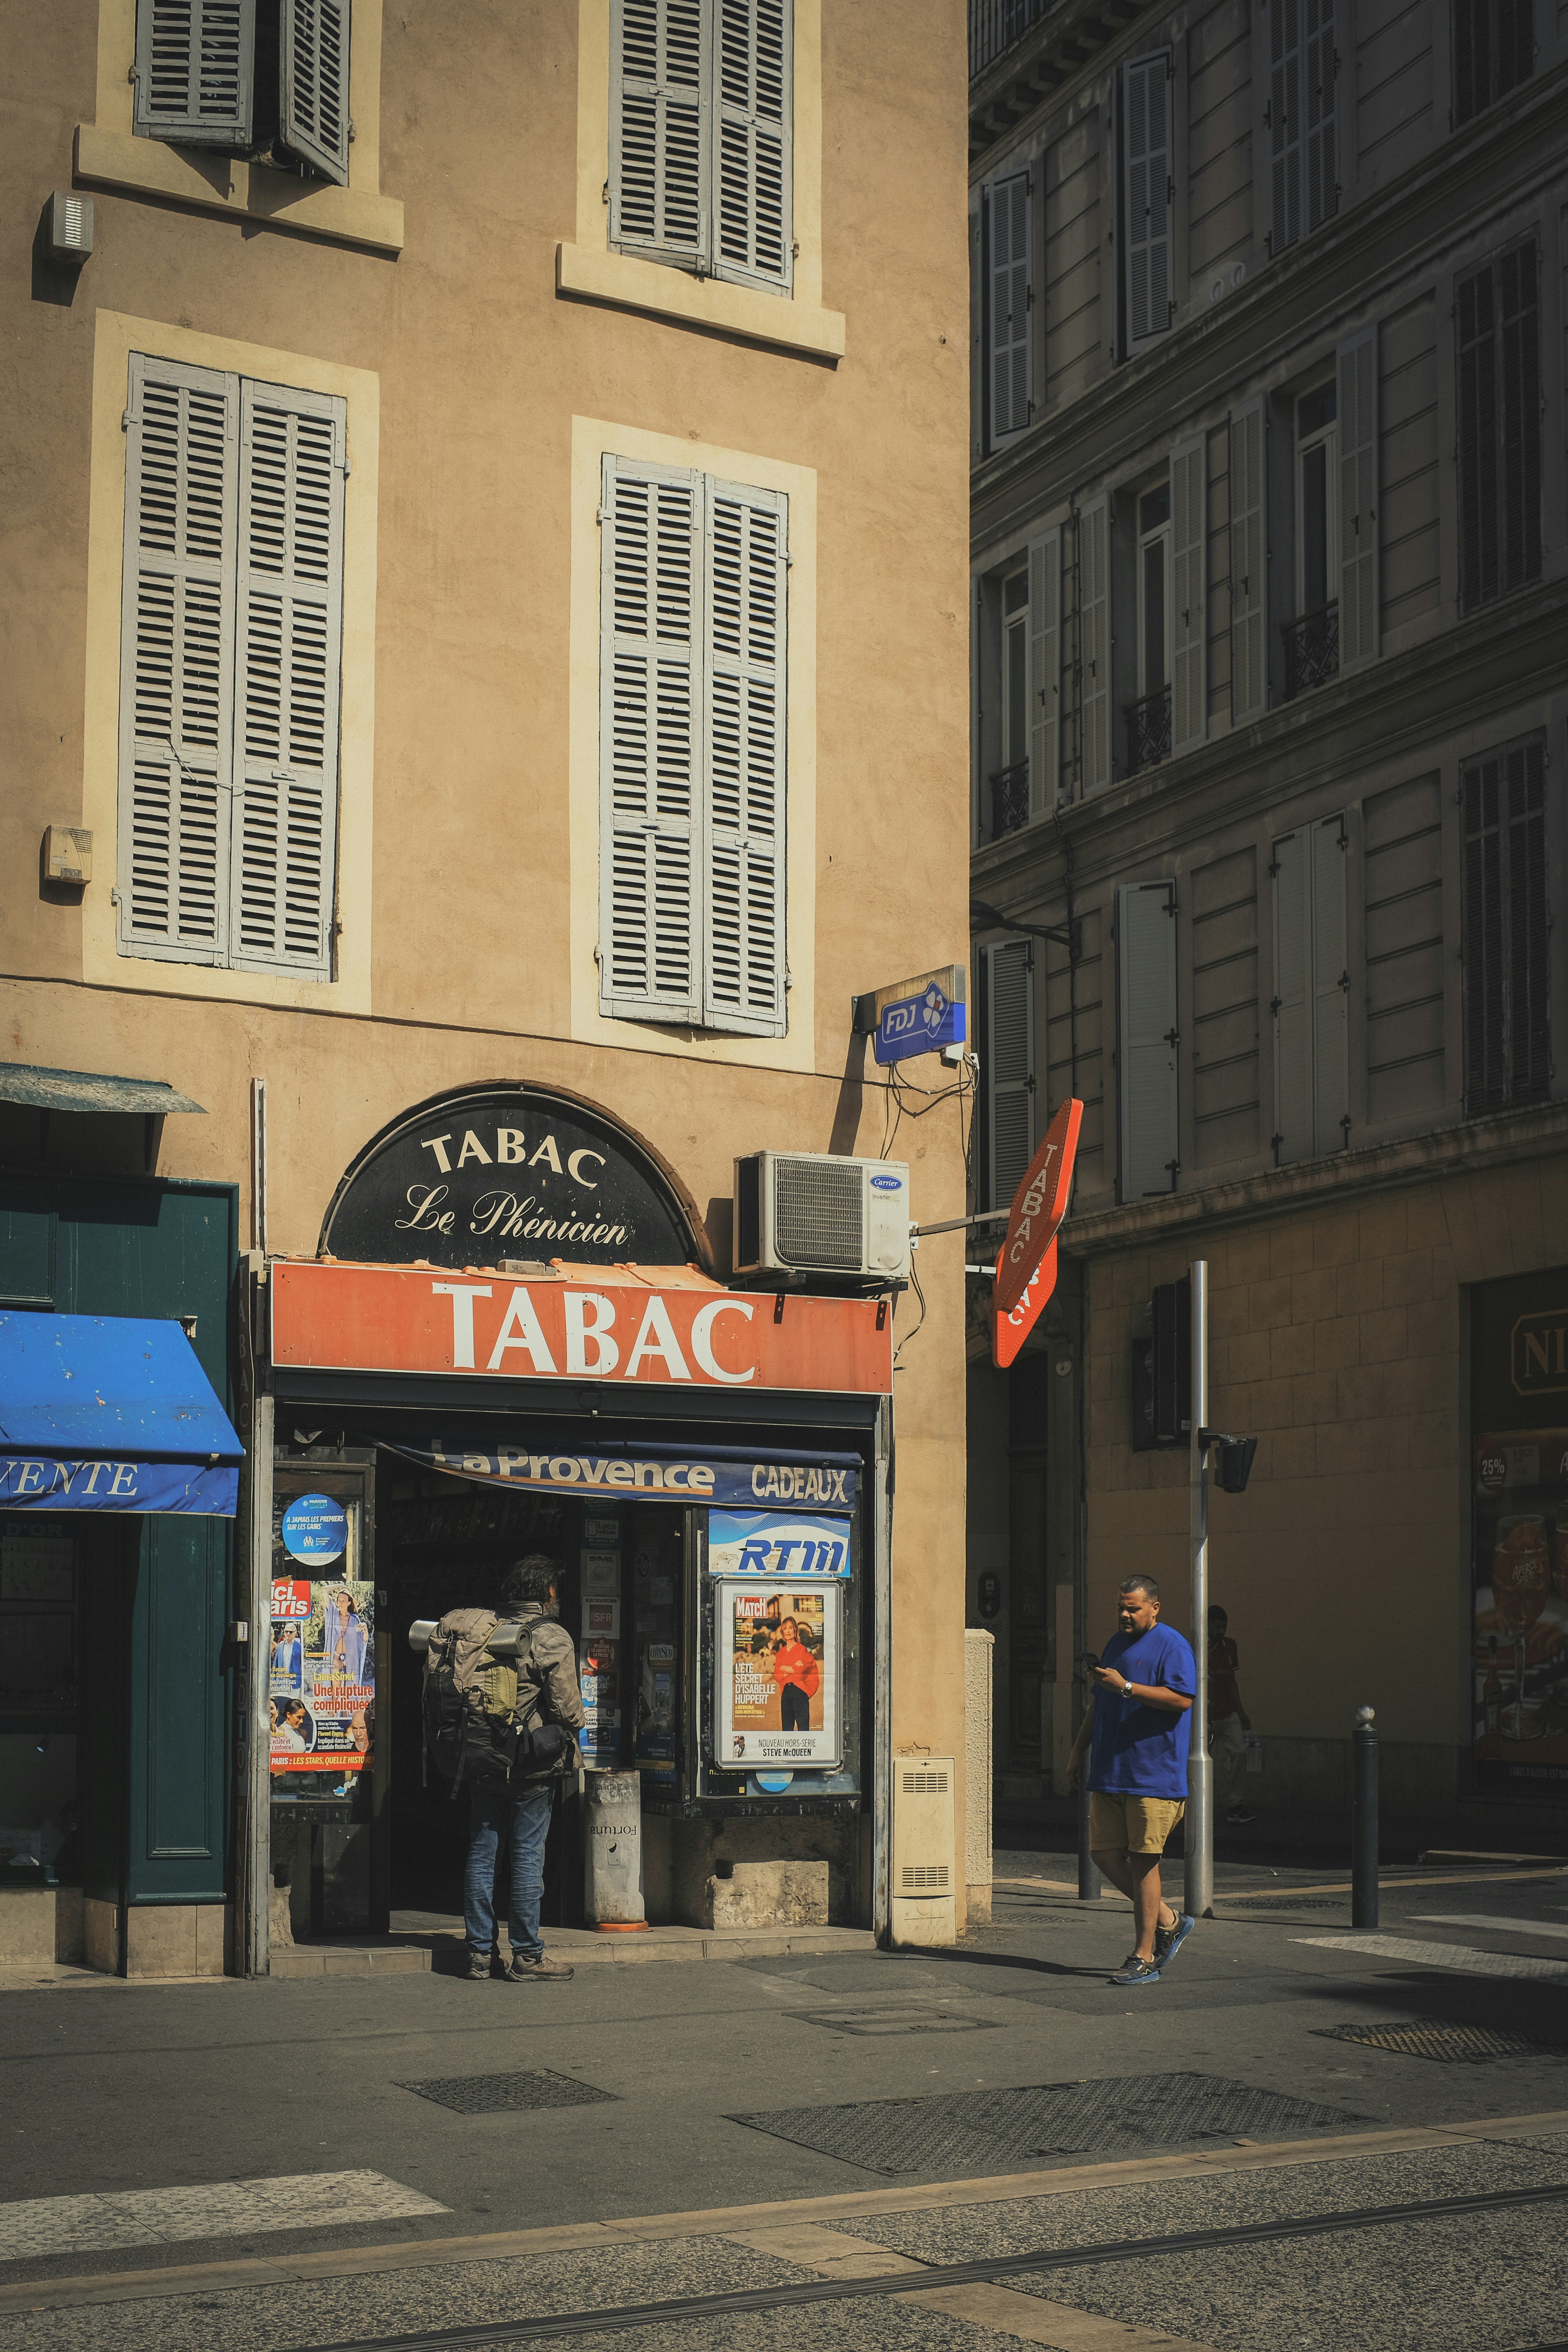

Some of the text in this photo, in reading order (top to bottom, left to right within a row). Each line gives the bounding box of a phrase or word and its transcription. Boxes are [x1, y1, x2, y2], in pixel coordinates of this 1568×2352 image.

[886, 1004, 917, 1035] FDJ
[421, 1127, 606, 1189] TABAC
[874, 1178, 899, 1187] Carrier
[1009, 1144, 1058, 1263] TABAC
[394, 1184, 631, 1246] Le Phénicien
[1008, 1262, 1042, 1326] BAC
[432, 1282, 755, 1383] TABAC
[238, 1263, 249, 1428] TABAC
[431, 1439, 716, 1491] La Provence
[1482, 1458, 1505, 1475] 25%
[751, 1464, 849, 1504] CADEAUX
[6, 1522, 64, 1537] D'OR
[598, 1522, 616, 1530] Lyca
[738, 1539, 844, 1572] RTM
[1512, 1559, 1538, 1579] APEROL
[737, 1597, 767, 1617] MATCH
[594, 1613, 612, 1622] SFR
[313, 1671, 354, 1681] Laura Smet
[735, 1673, 763, 1684] SECRET
[313, 1683, 374, 1700] Une rupture
[735, 1683, 776, 1694] D'ISABELLE
[238, 1645, 247, 1770] LOTO
[735, 1694, 769, 1704] HUPPERT
[758, 1738, 816, 1747] NOUVEAU HORS-SÉRIE
[305, 1756, 325, 1766] STARS,
[325, 1756, 348, 1766] QUELLE
[348, 1756, 372, 1764] HISTOIRE
[783, 1749, 812, 1757] McQUEEN
[1526, 1767, 1548, 1778] D'ALCOOL
[1550, 1769, 1558, 1778] EST
[590, 1825, 637, 1836] Fortuna
